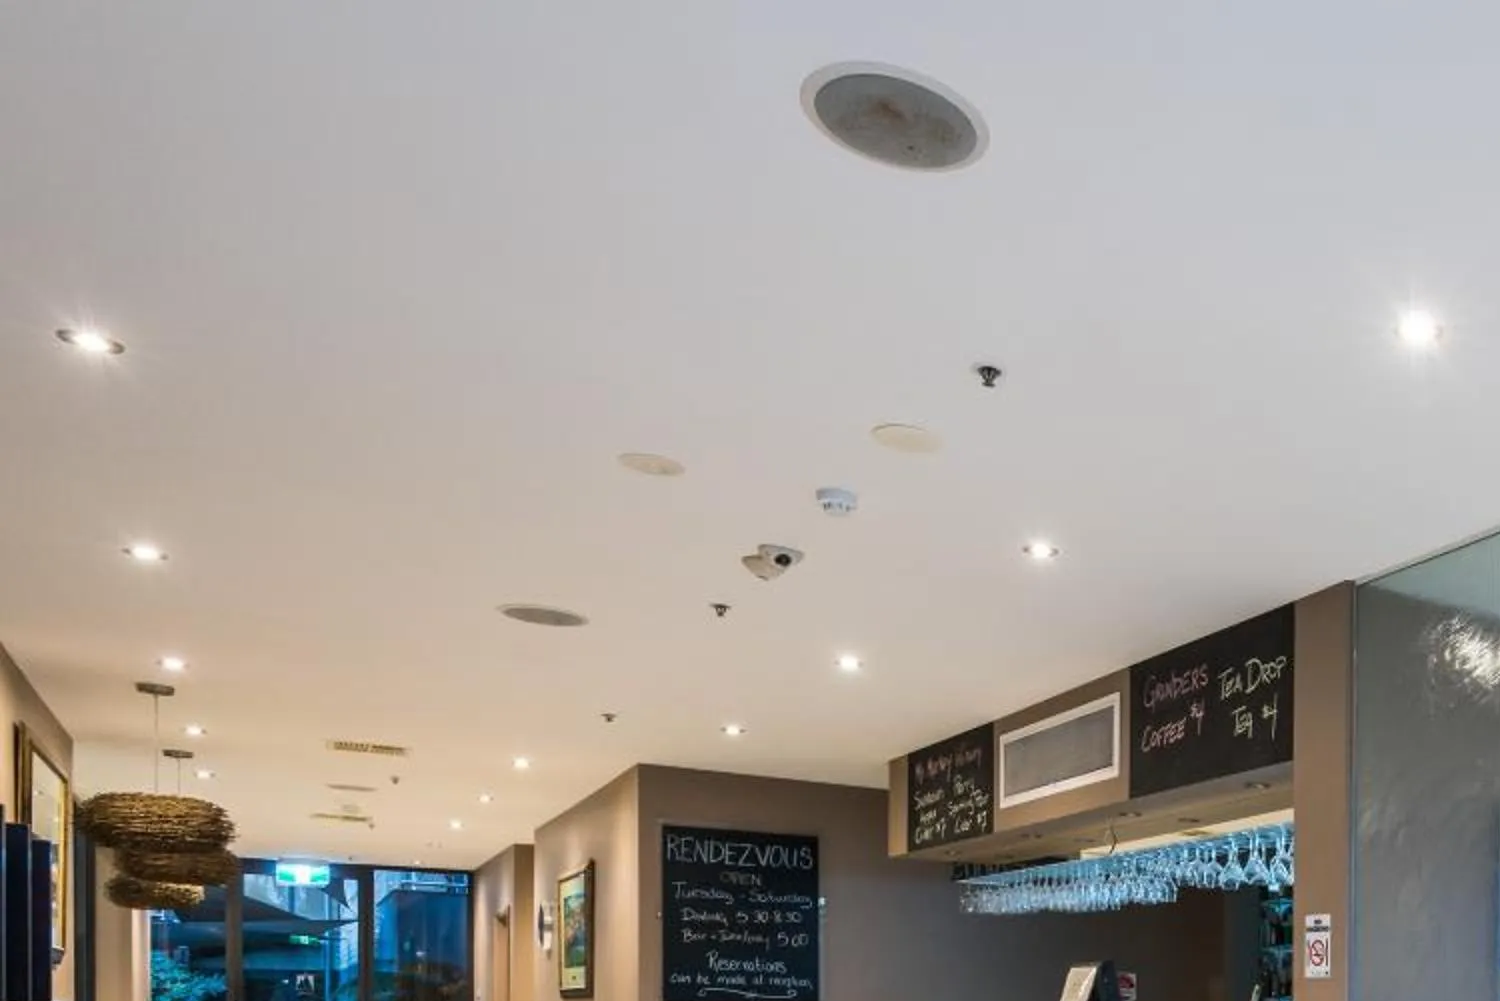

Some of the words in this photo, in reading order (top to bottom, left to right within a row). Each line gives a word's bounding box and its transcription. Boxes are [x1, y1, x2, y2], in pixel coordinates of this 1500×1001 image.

[667, 834, 814, 870] RENDEZVOUS
[671, 881, 735, 905] Tuesday
[706, 950, 787, 974] Reservations
